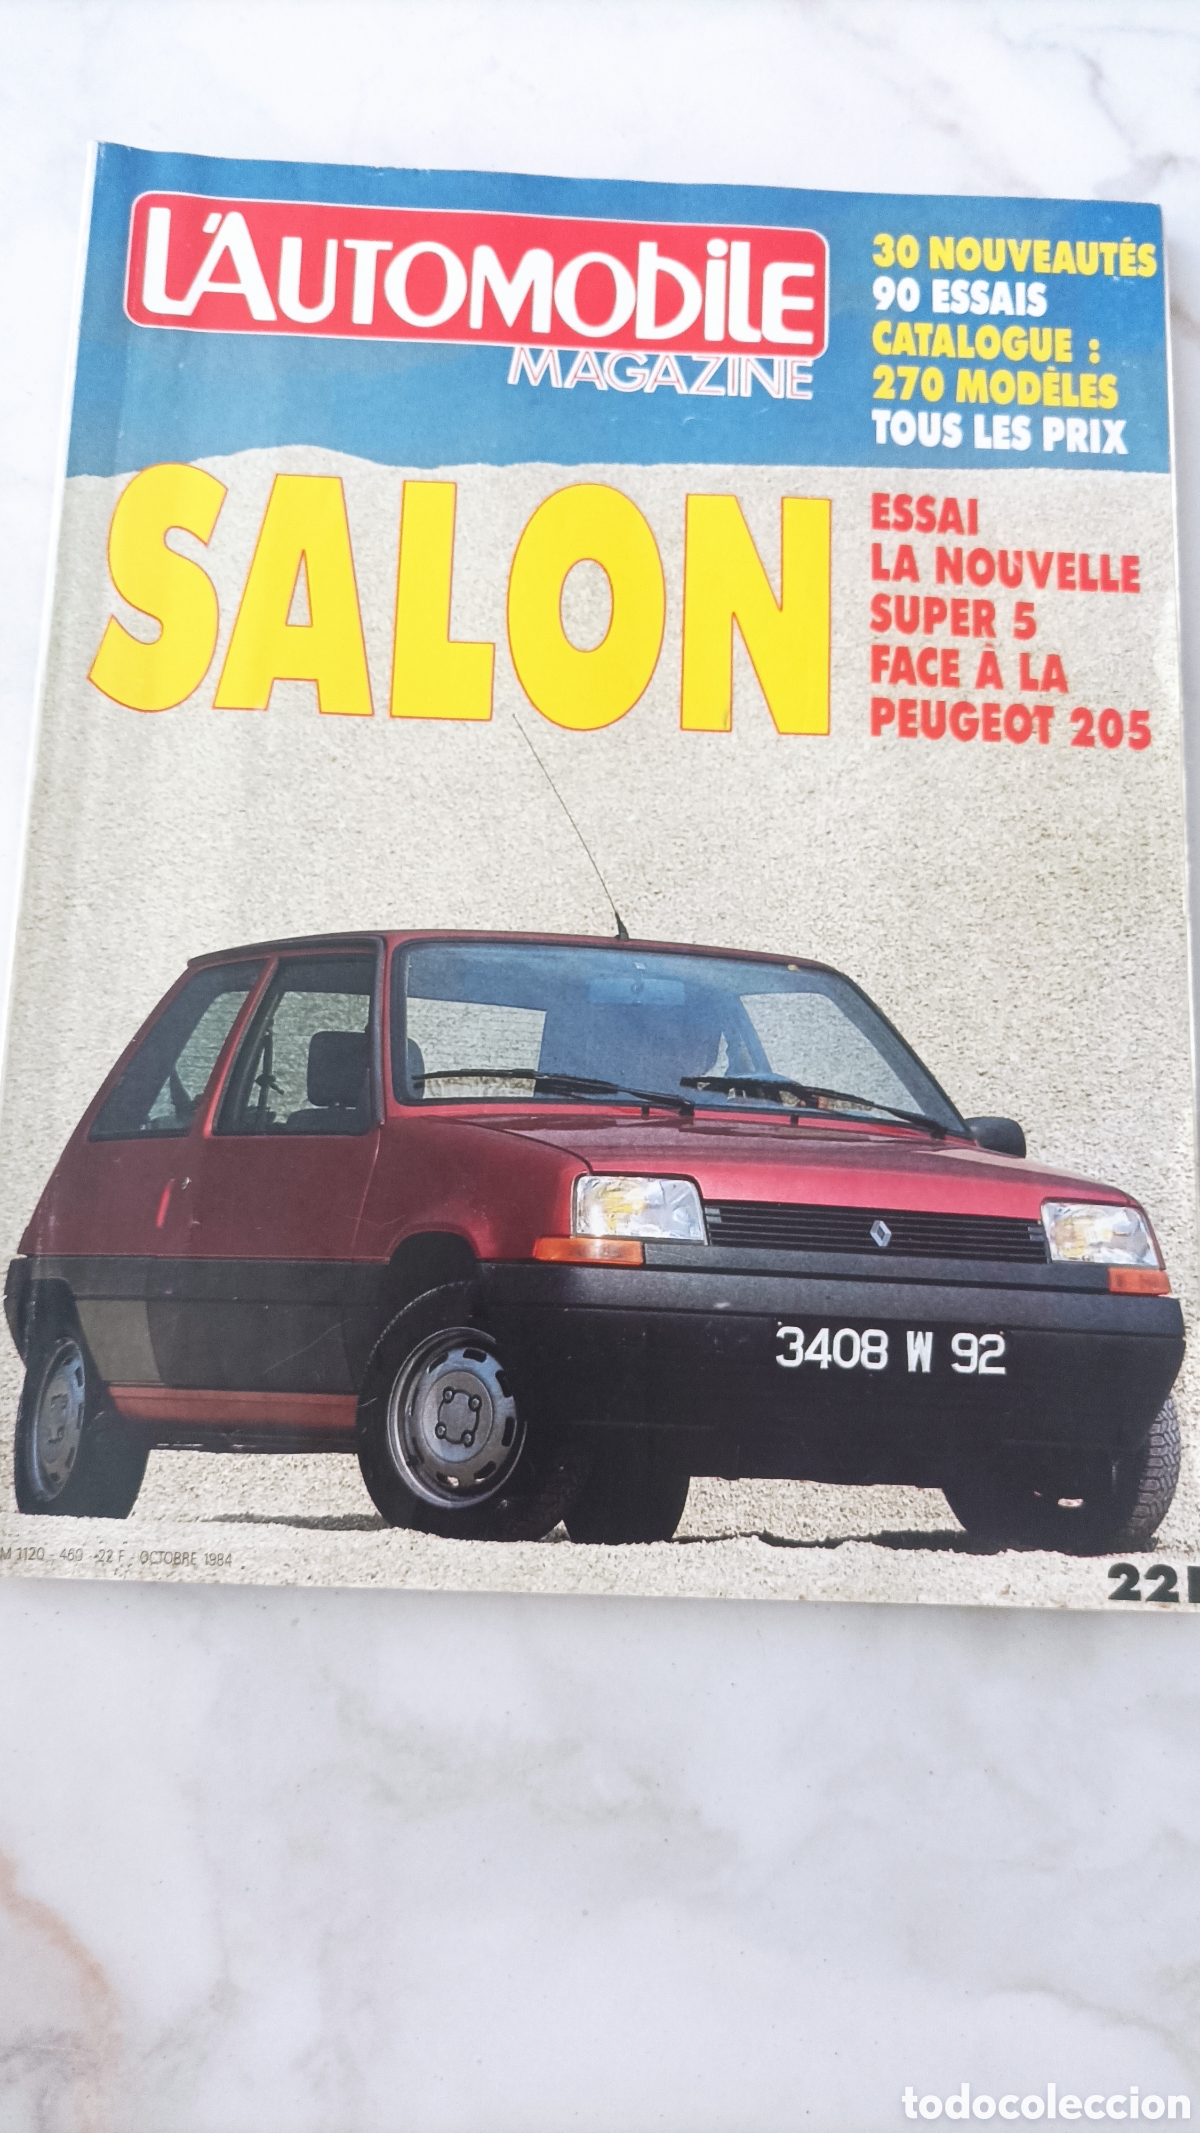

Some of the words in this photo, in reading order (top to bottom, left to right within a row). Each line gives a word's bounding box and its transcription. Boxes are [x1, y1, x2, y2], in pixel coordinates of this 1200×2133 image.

[872, 233, 919, 269] 30
[929, 236, 1157, 278] NOUVEAUTÉS
[872, 276, 920, 312] 90
[932, 279, 1048, 317] ESSAIS
[872, 321, 1073, 363] CATALOGUE
[507, 346, 813, 400] MAGAZINE
[872, 365, 945, 402] 270
[956, 366, 1118, 409] MODÈLES
[871, 409, 962, 449] TOUS
[974, 414, 1031, 451] LES
[1042, 416, 1128, 455] PRIX
[871, 493, 978, 536] ESSAI
[871, 543, 920, 583] LA
[935, 546, 1140, 594] NOUVELLE
[87, 462, 831, 735] SALON
[870, 593, 996, 638] SUPER
[1013, 601, 1037, 640] 5
[870, 645, 960, 688] FACE
[975, 643, 1004, 690] À
[1019, 652, 1069, 694] LA
[870, 697, 1054, 745] PEUGEOT
[1070, 707, 1152, 751] 205
[776, 1326, 889, 1370] 3408
[906, 1331, 933, 1374] W
[951, 1332, 1006, 1375] 92
[140, 1550, 197, 1567] OCTOBRE
[204, 1552, 232, 1568] 1984
